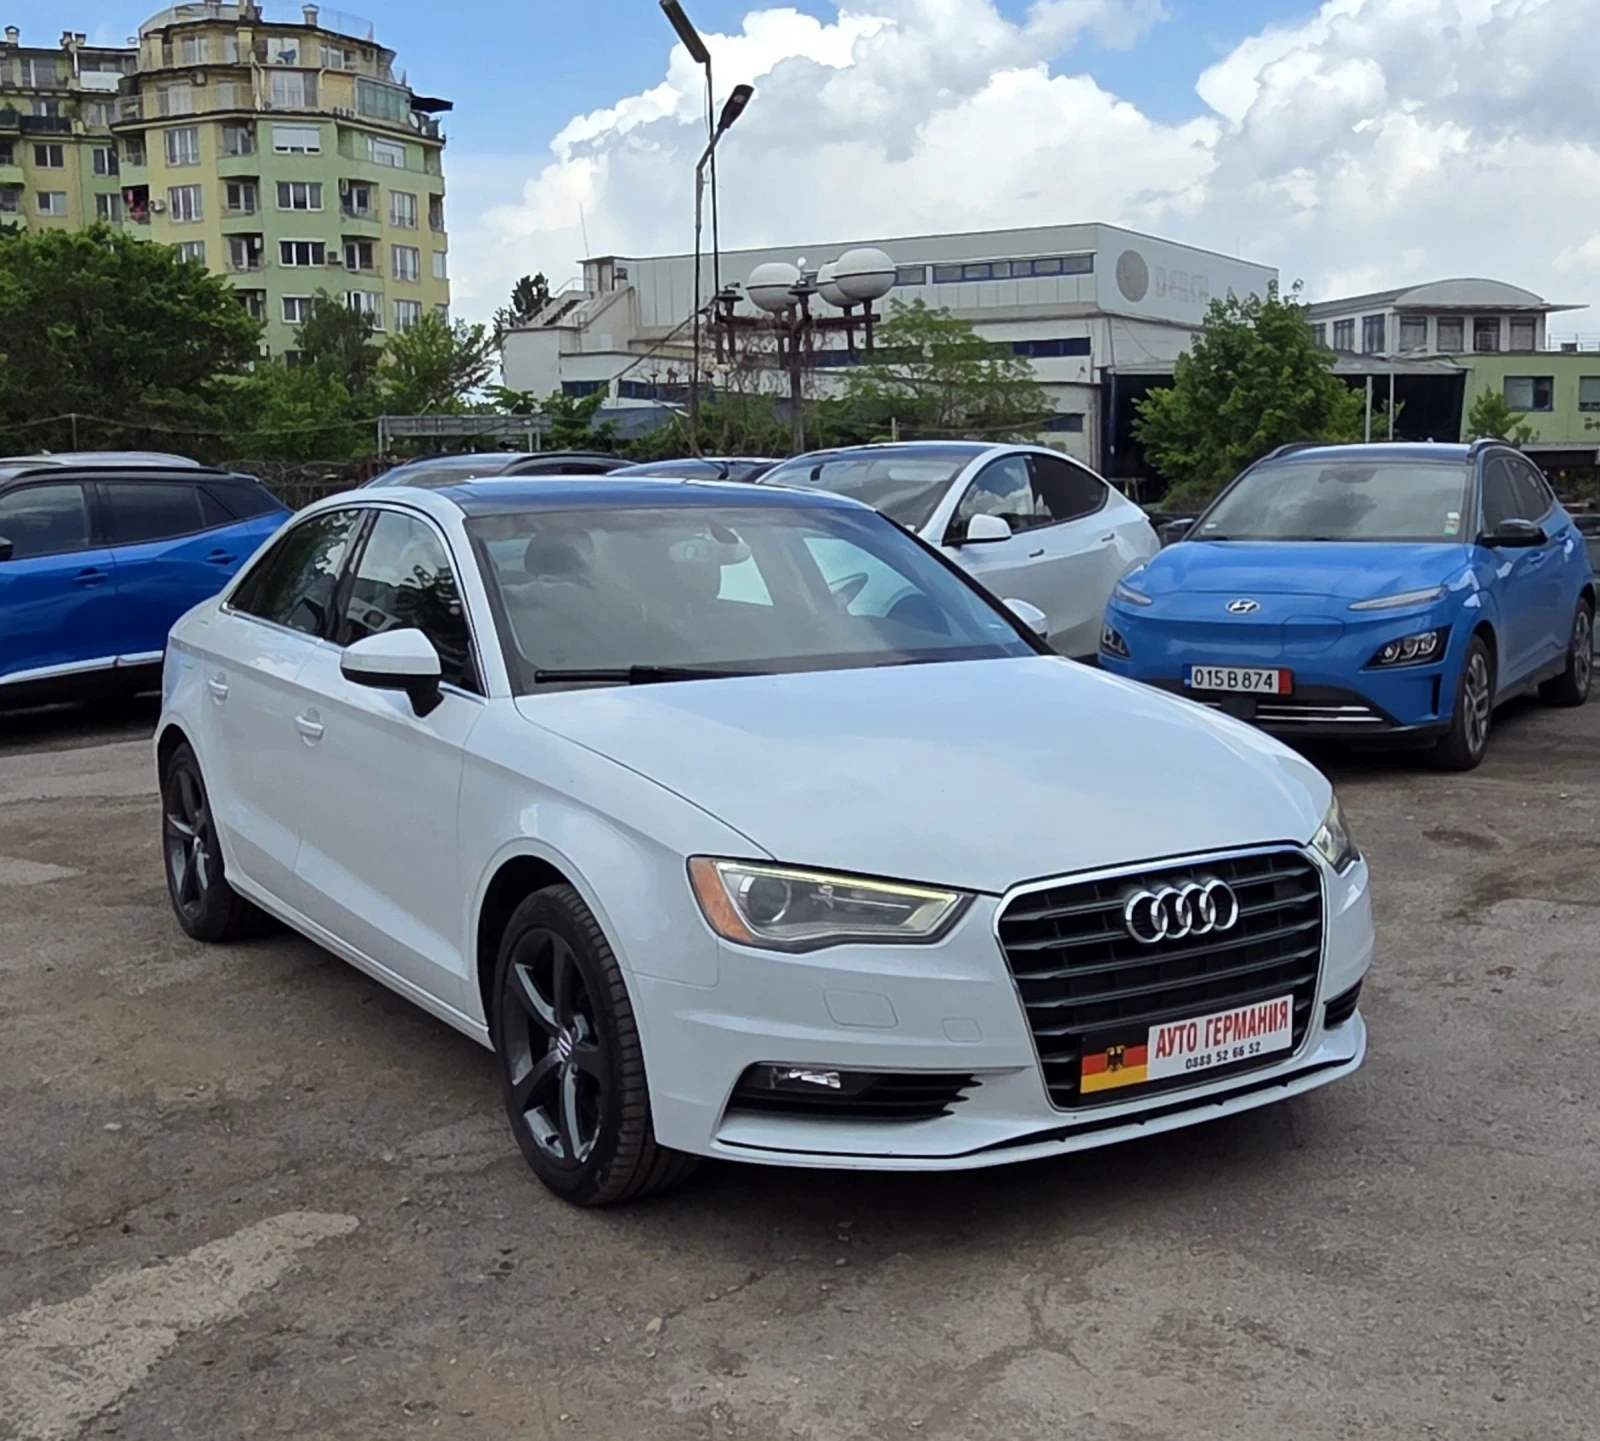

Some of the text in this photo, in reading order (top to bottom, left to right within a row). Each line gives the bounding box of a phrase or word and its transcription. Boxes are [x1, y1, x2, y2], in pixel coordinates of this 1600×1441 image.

[1155, 1000, 1288, 1059] АУТО ГЕРМАНИЯ
[1216, 1049, 1229, 1062] 52
[1232, 1045, 1245, 1058] 66
[1248, 1041, 1261, 1054] 52
